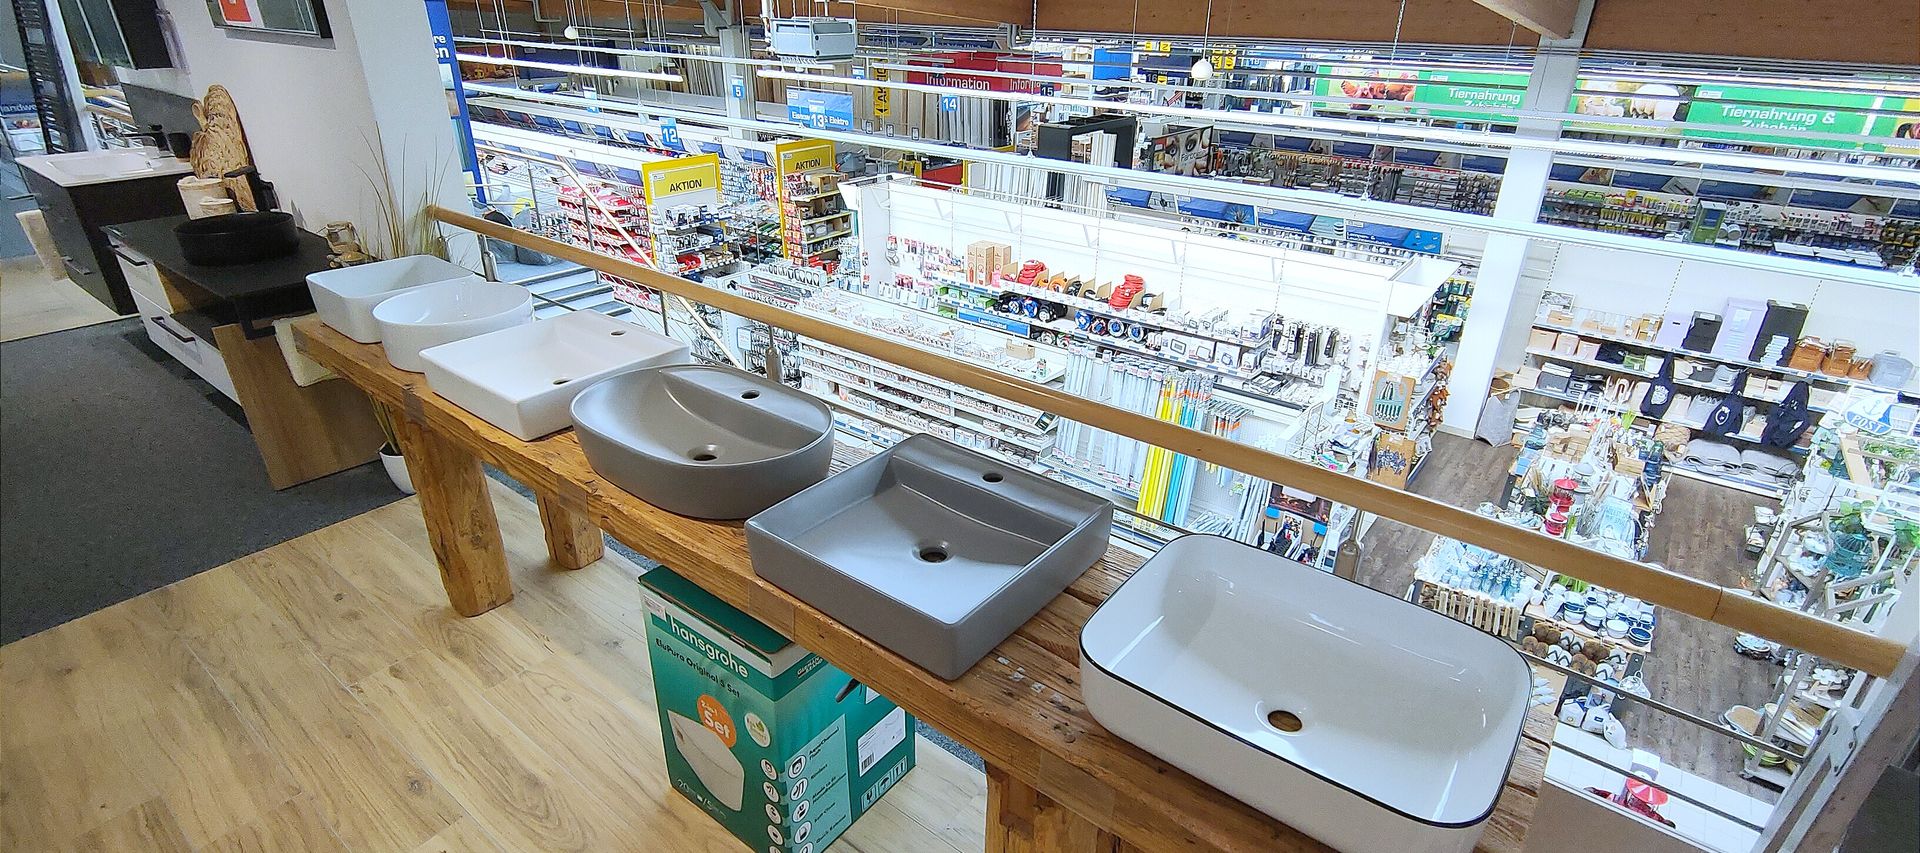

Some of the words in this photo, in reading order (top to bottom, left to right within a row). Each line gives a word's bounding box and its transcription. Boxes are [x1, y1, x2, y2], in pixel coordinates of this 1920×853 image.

[926, 73, 990, 91] Information
[735, 88, 742, 97] 5
[1041, 86, 1054, 96] 15
[1449, 87, 1521, 105] Tiernahrung
[943, 97, 957, 110] 14
[811, 113, 825, 128] 13
[1721, 104, 1817, 125] Tiernahrung
[1821, 111, 1836, 125] &
[662, 127, 679, 143] 12
[795, 157, 821, 171] AKTION
[669, 178, 702, 193] AKTION
[1850, 414, 1883, 434] POST
[671, 615, 749, 678] hansgrohe
[687, 657, 719, 684] Original
[727, 683, 740, 698] Set
[704, 710, 731, 740] Set
